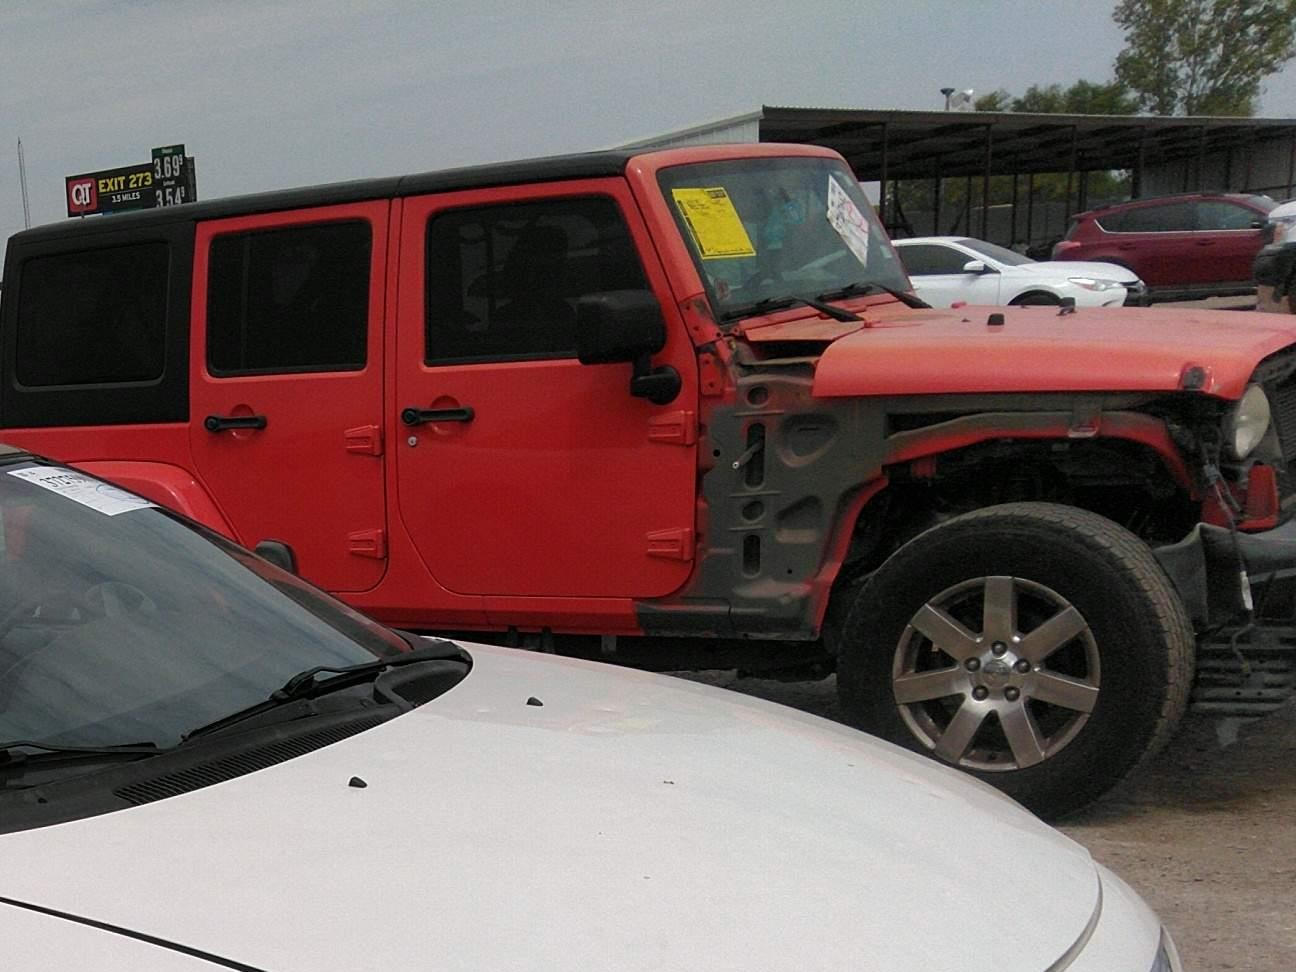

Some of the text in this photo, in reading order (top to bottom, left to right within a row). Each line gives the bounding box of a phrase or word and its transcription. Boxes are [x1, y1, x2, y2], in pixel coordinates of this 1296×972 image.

[98, 176, 125, 193] EXIT
[129, 172, 152, 188] 273
[71, 183, 91, 206] QT
[121, 192, 141, 202] MILES
